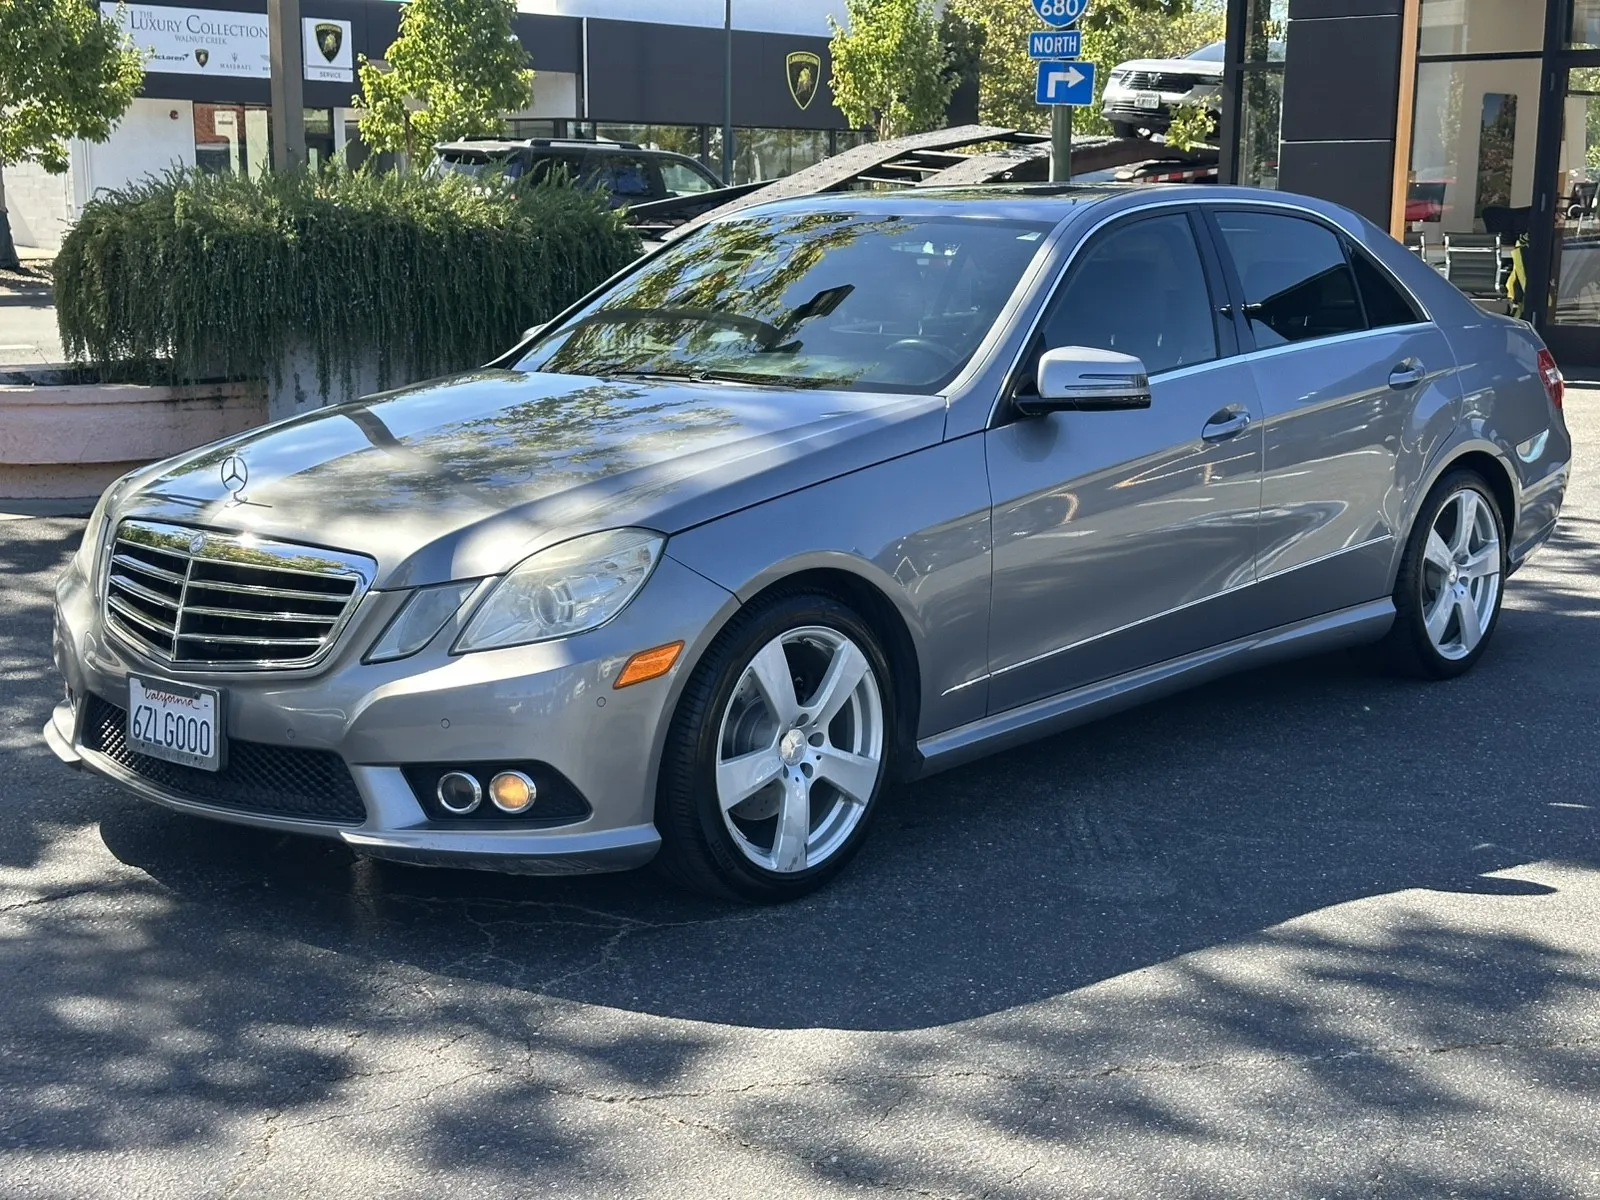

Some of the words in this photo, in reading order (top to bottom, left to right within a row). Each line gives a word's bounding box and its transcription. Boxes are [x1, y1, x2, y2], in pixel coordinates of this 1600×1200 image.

[140, 11, 153, 19] THE
[1040, 0, 1079, 16] 680
[186, 15, 268, 38] COLLECTION
[174, 34, 205, 45] WALNUT
[205, 36, 228, 46] CREEK
[1033, 35, 1077, 54] NORTH
[320, 71, 341, 79] SERVICE
[133, 705, 210, 755] 6ZLG000
